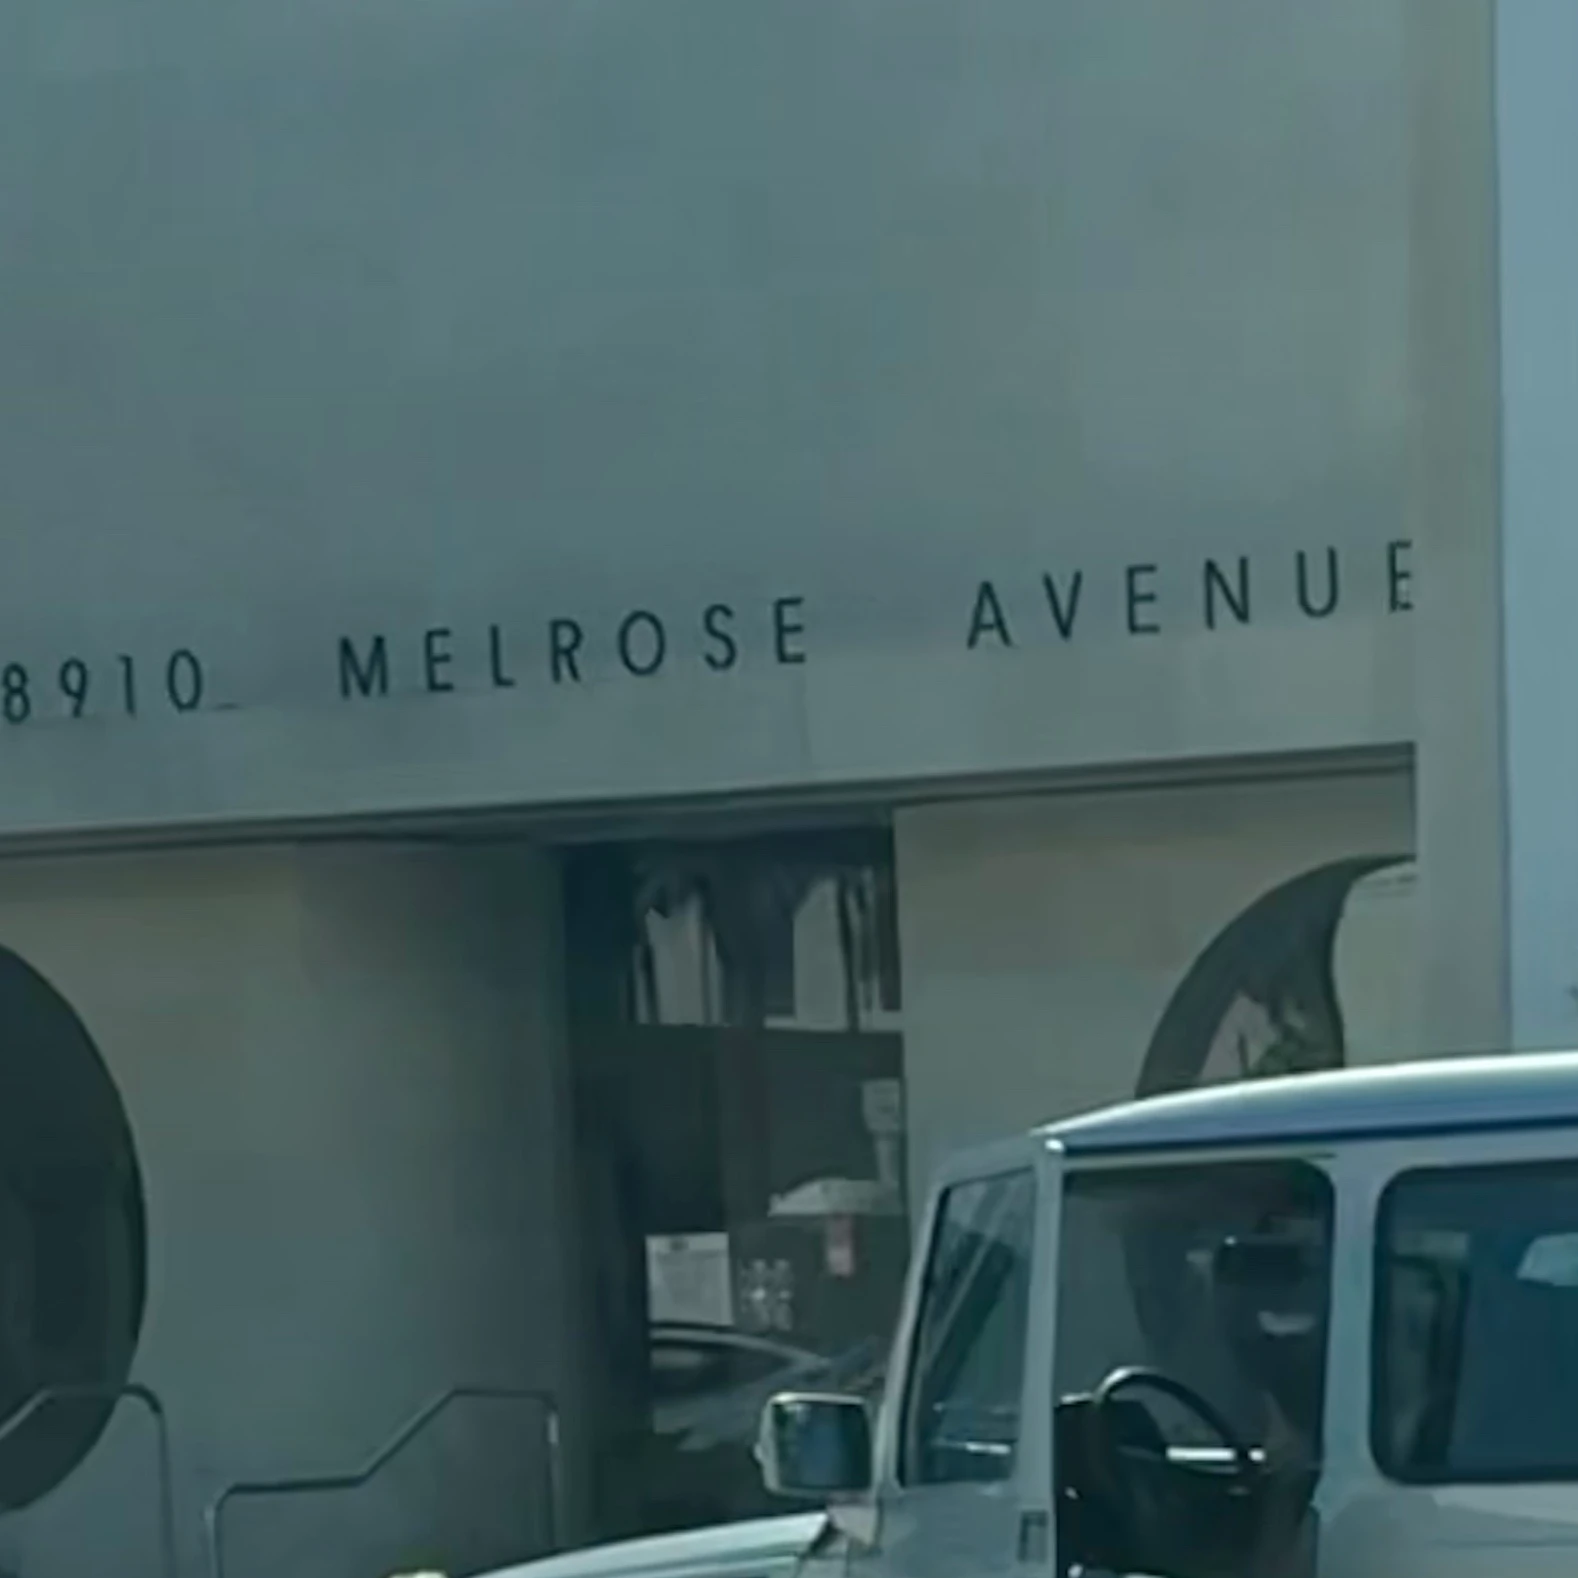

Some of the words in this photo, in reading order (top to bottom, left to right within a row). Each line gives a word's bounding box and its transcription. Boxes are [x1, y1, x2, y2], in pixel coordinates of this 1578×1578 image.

[1, 648, 204, 725] 8910
[339, 596, 807, 700] MELROSE
[966, 539, 1414, 649] AVENUE
